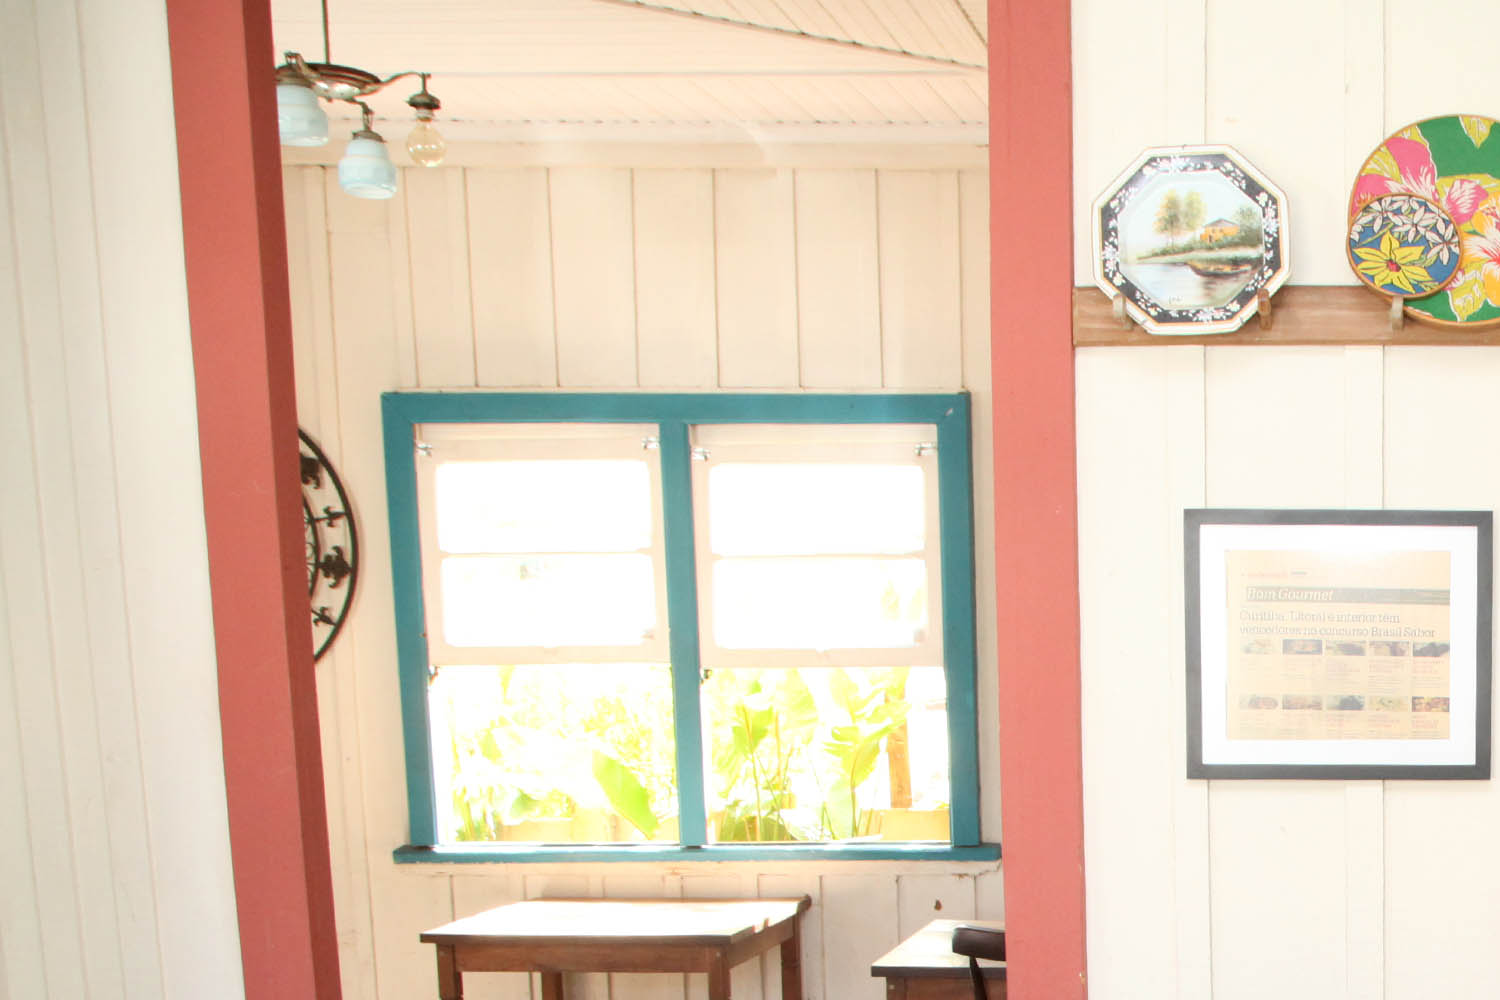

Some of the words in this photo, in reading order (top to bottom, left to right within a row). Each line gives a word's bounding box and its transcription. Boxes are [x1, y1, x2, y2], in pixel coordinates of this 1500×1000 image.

[1278, 587, 1334, 602] Gourmet
[1371, 625, 1402, 637] Brasil
[1404, 626, 1436, 638] Sabor
